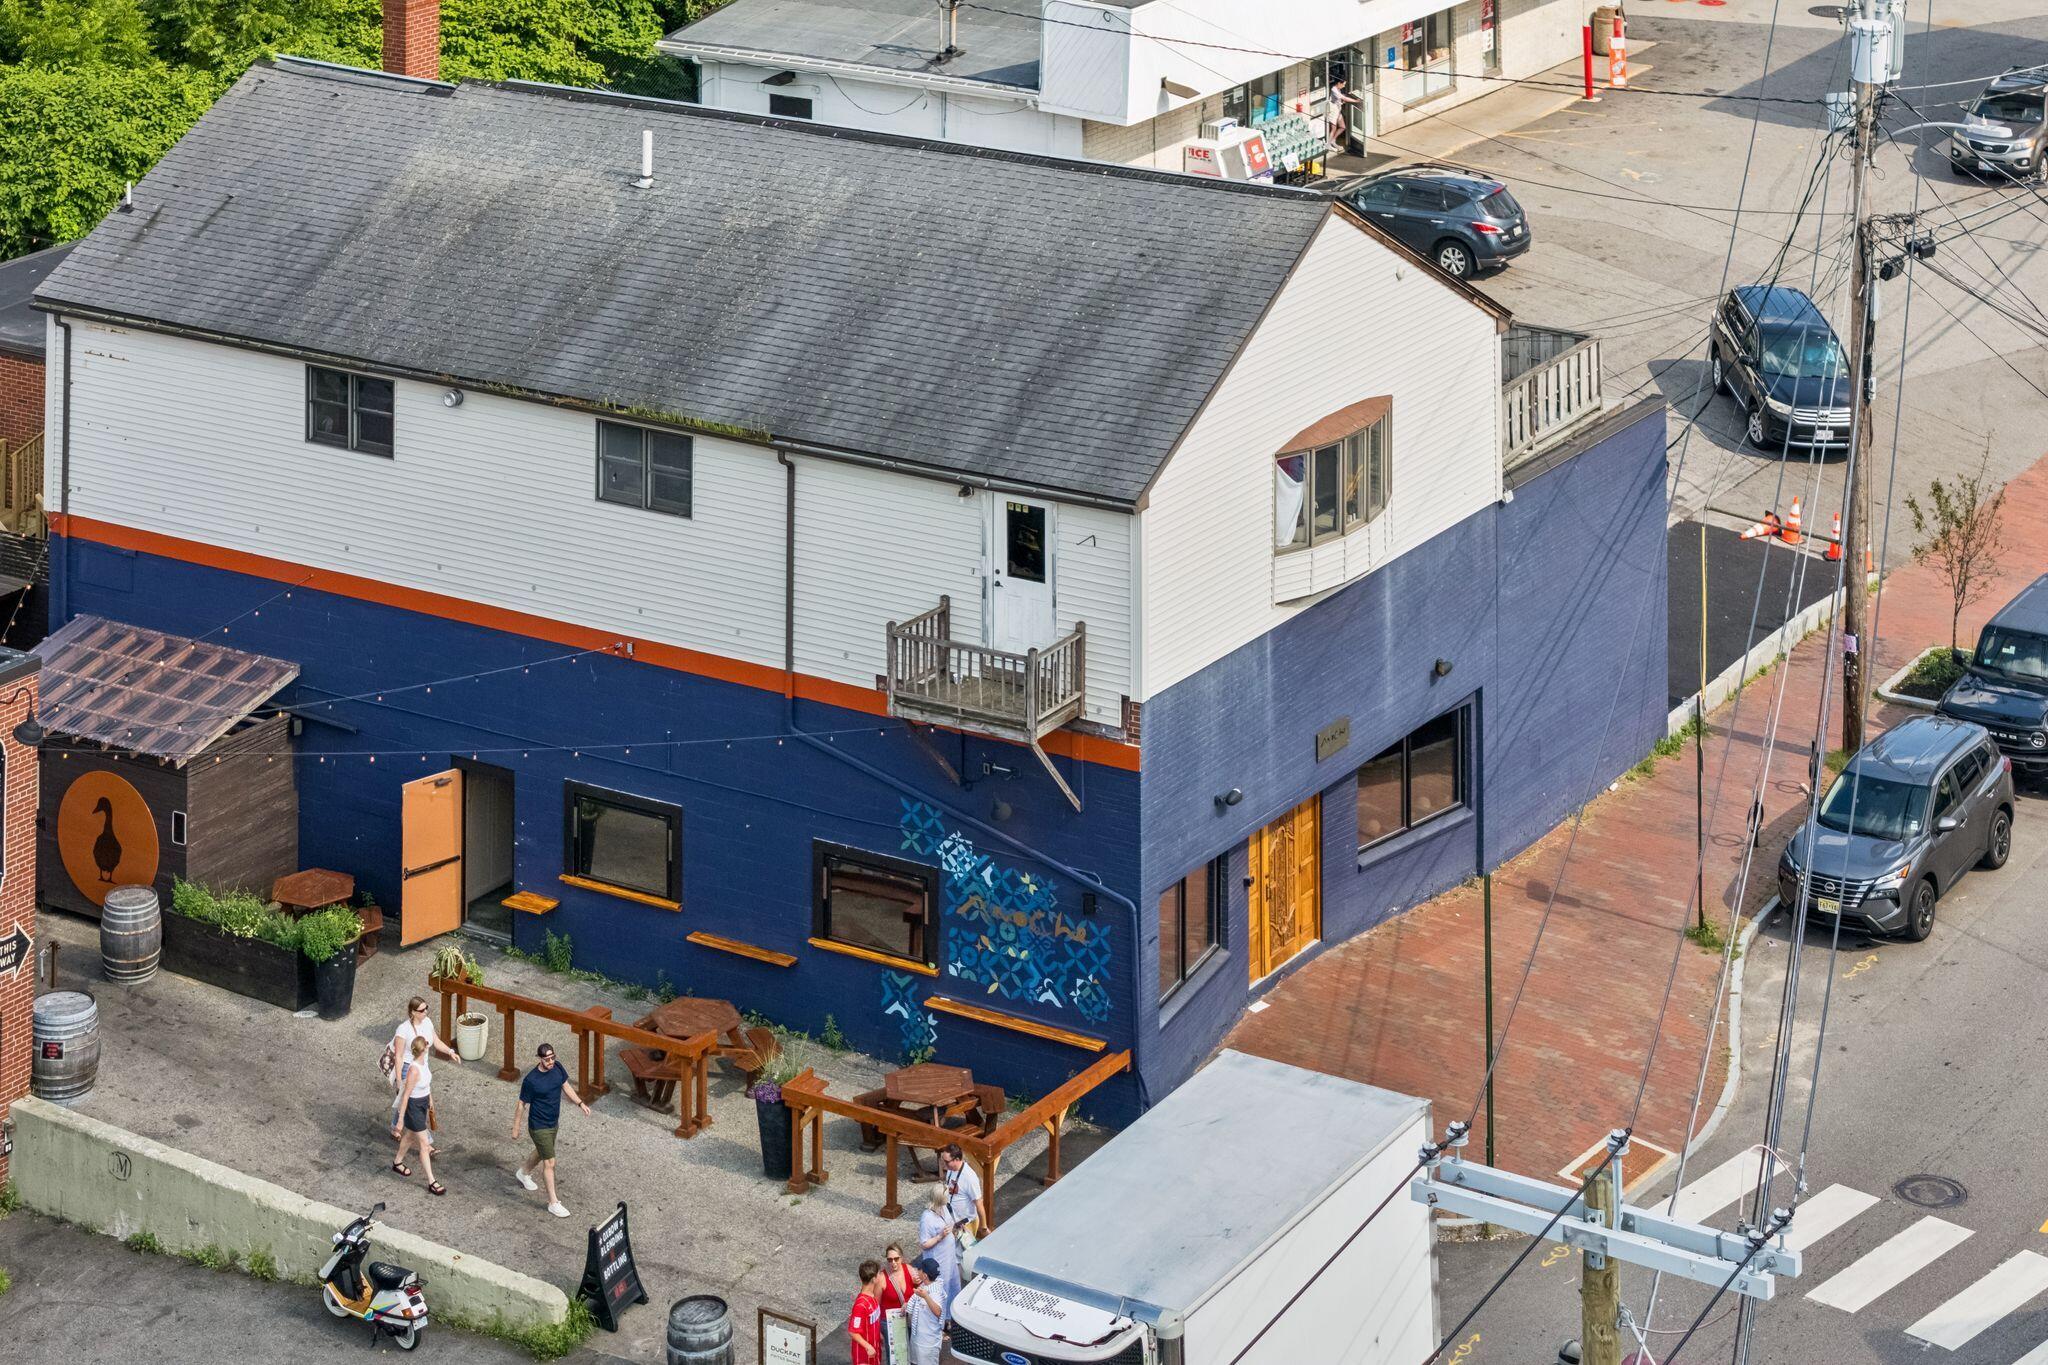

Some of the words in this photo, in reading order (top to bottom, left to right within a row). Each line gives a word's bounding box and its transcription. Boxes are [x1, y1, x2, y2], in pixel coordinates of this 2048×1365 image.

[1191, 148, 1209, 158] ICE
[0, 940, 17, 956] THIS
[0, 952, 16, 968] WAY
[602, 1219, 619, 1242] OXBOW
[600, 1229, 624, 1257] BLENDING
[603, 1252, 628, 1280] BOTTLING
[770, 1345, 800, 1358] DUCKFAT
